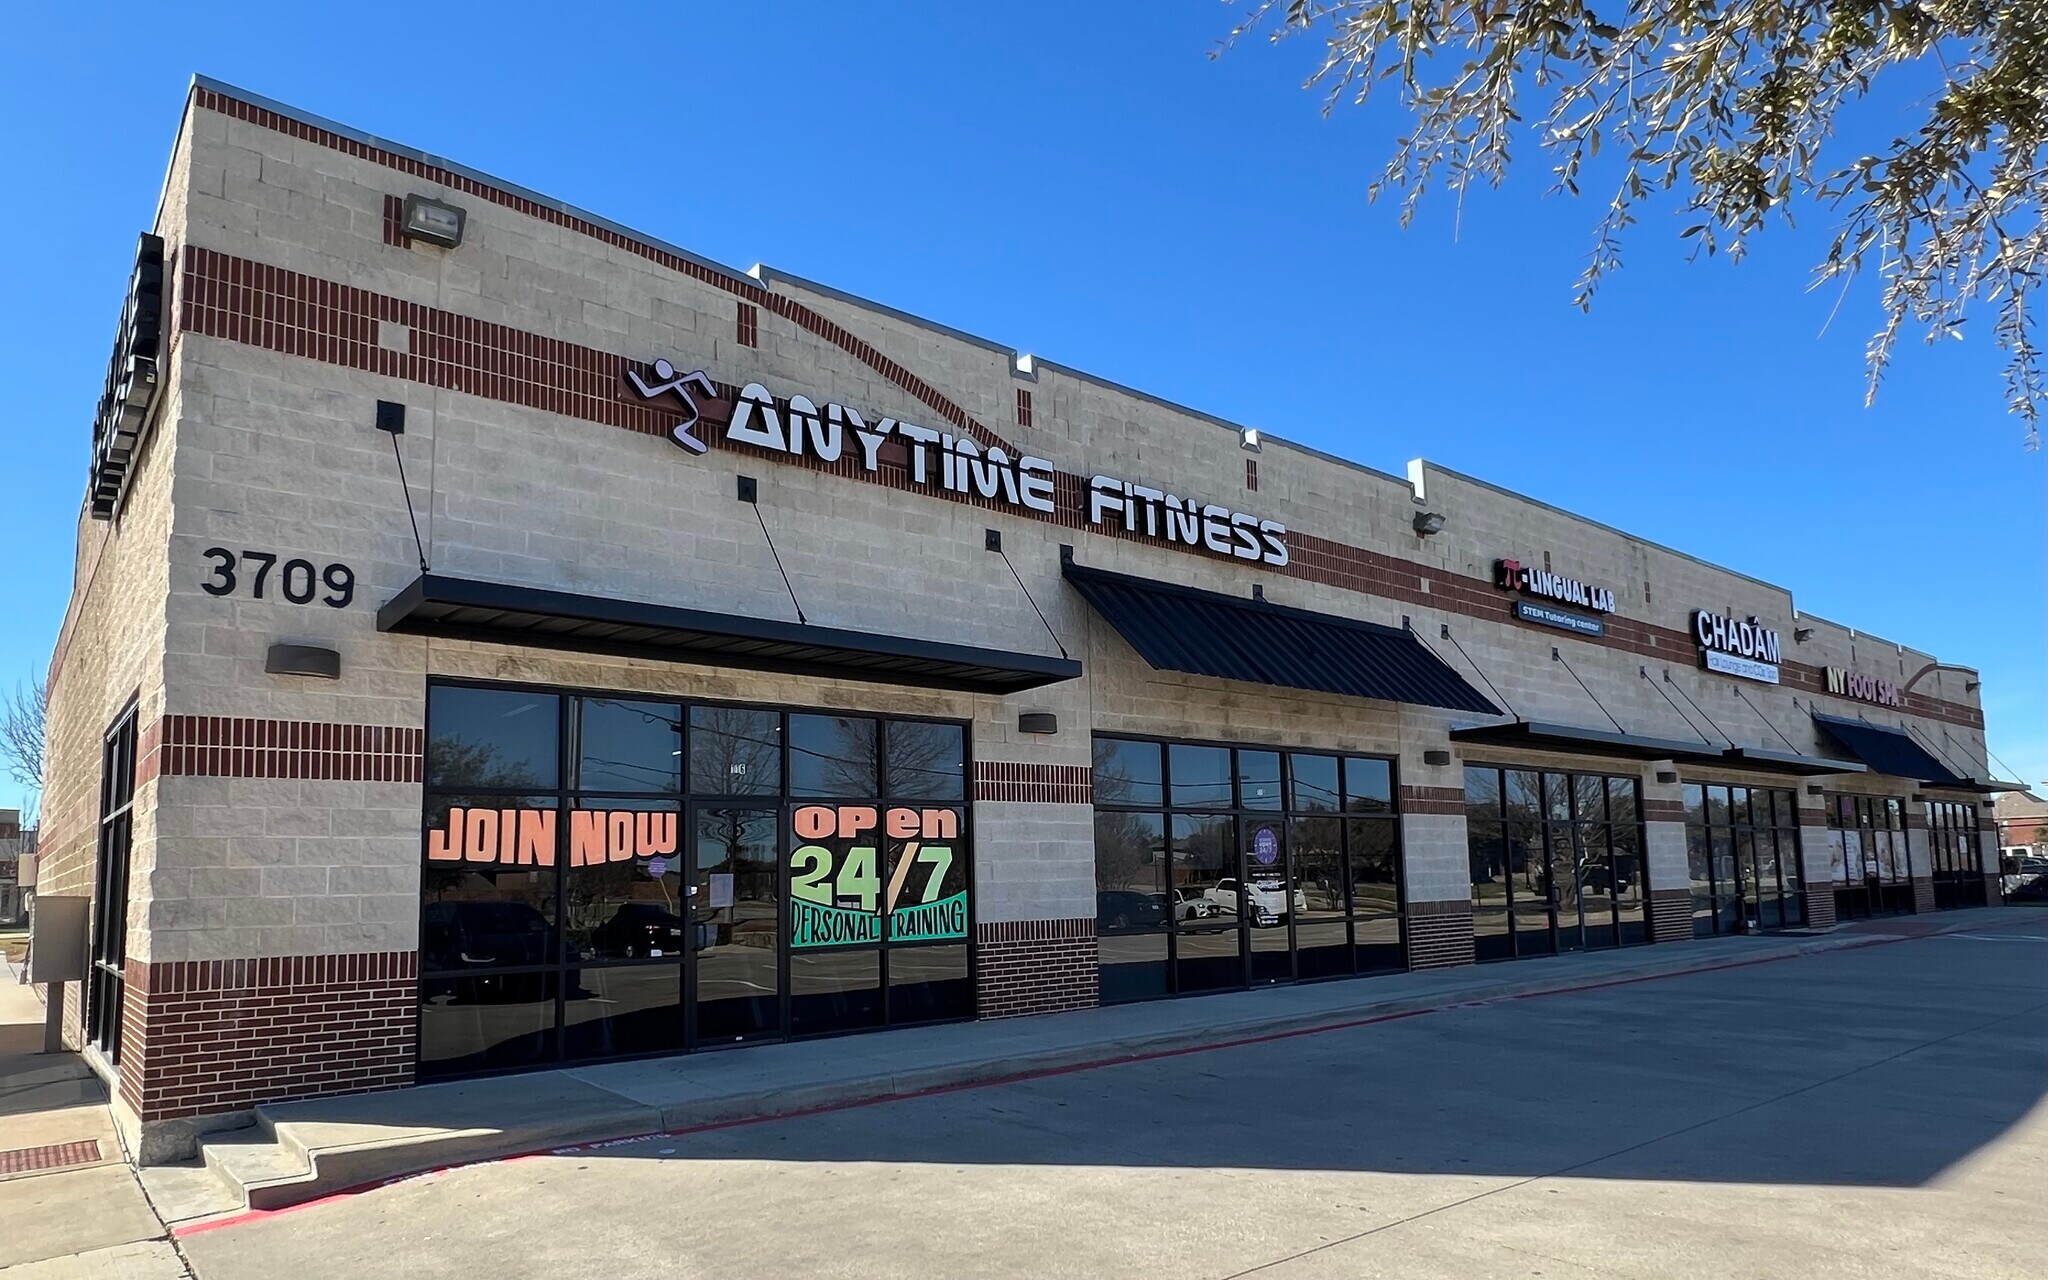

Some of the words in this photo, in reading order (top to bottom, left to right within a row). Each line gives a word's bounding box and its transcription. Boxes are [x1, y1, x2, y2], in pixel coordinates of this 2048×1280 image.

[725, 382, 1055, 513] ANYTIME
[1091, 474, 1289, 567] FITNESS
[201, 547, 355, 608] 3709
[1591, 586, 1616, 613] LAB
[1522, 606, 1544, 618] STEM
[1544, 611, 1576, 628] Tutoring
[1827, 666, 1845, 694] NY
[428, 807, 557, 867] JOIN
[570, 810, 678, 867] NOW
[790, 842, 953, 915] 24/7
[791, 901, 880, 944] PERSONAL
[888, 899, 965, 938] TRAINING
